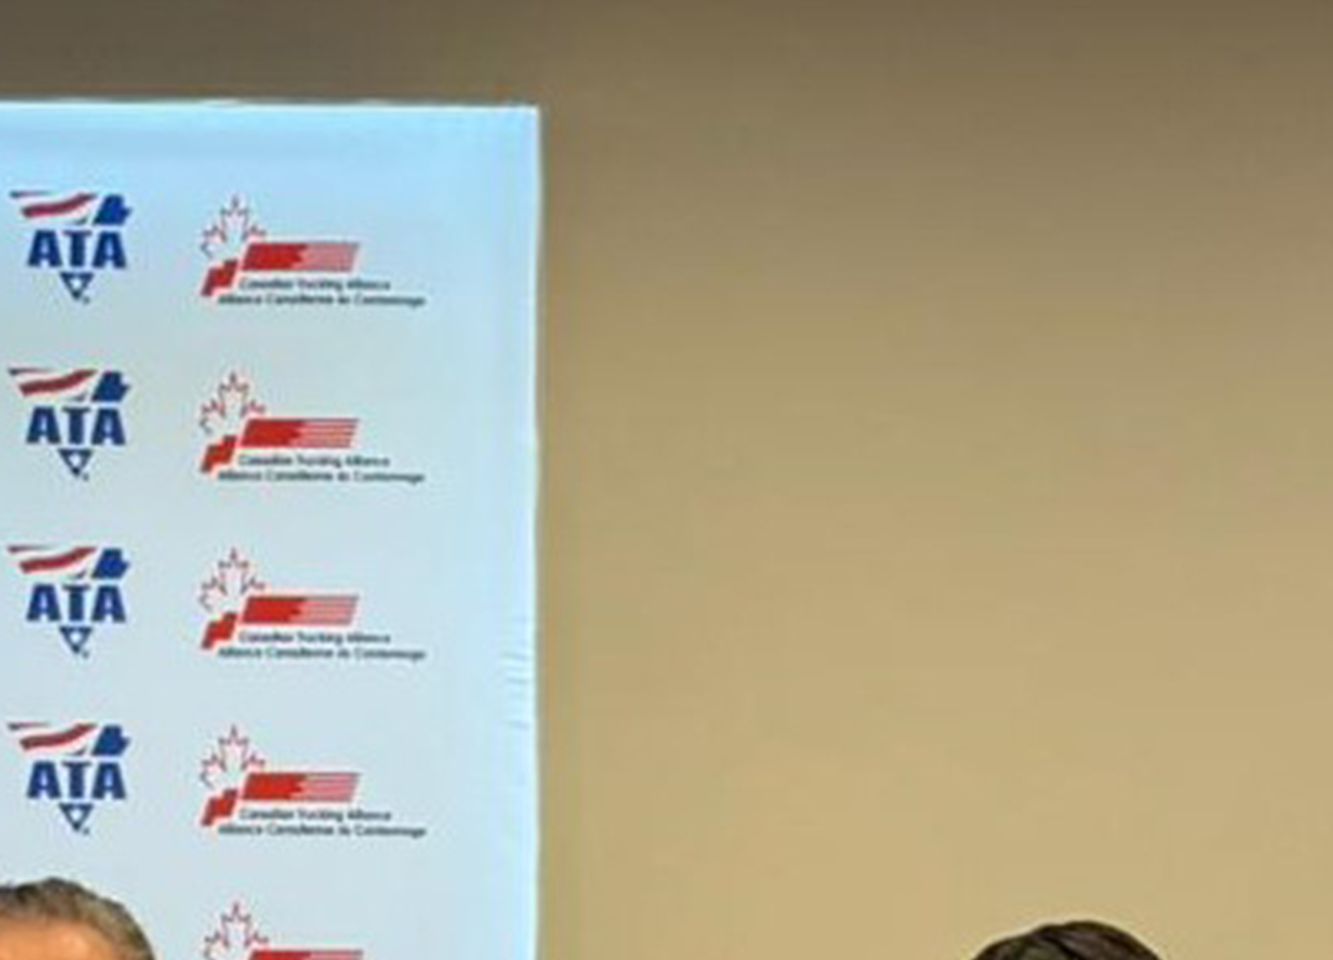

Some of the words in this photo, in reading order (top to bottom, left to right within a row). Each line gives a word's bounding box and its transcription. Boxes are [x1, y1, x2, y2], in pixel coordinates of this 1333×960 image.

[28, 230, 126, 268] ATA
[27, 407, 125, 445] ATA
[27, 584, 125, 621] ATA
[28, 762, 125, 799] ATA
